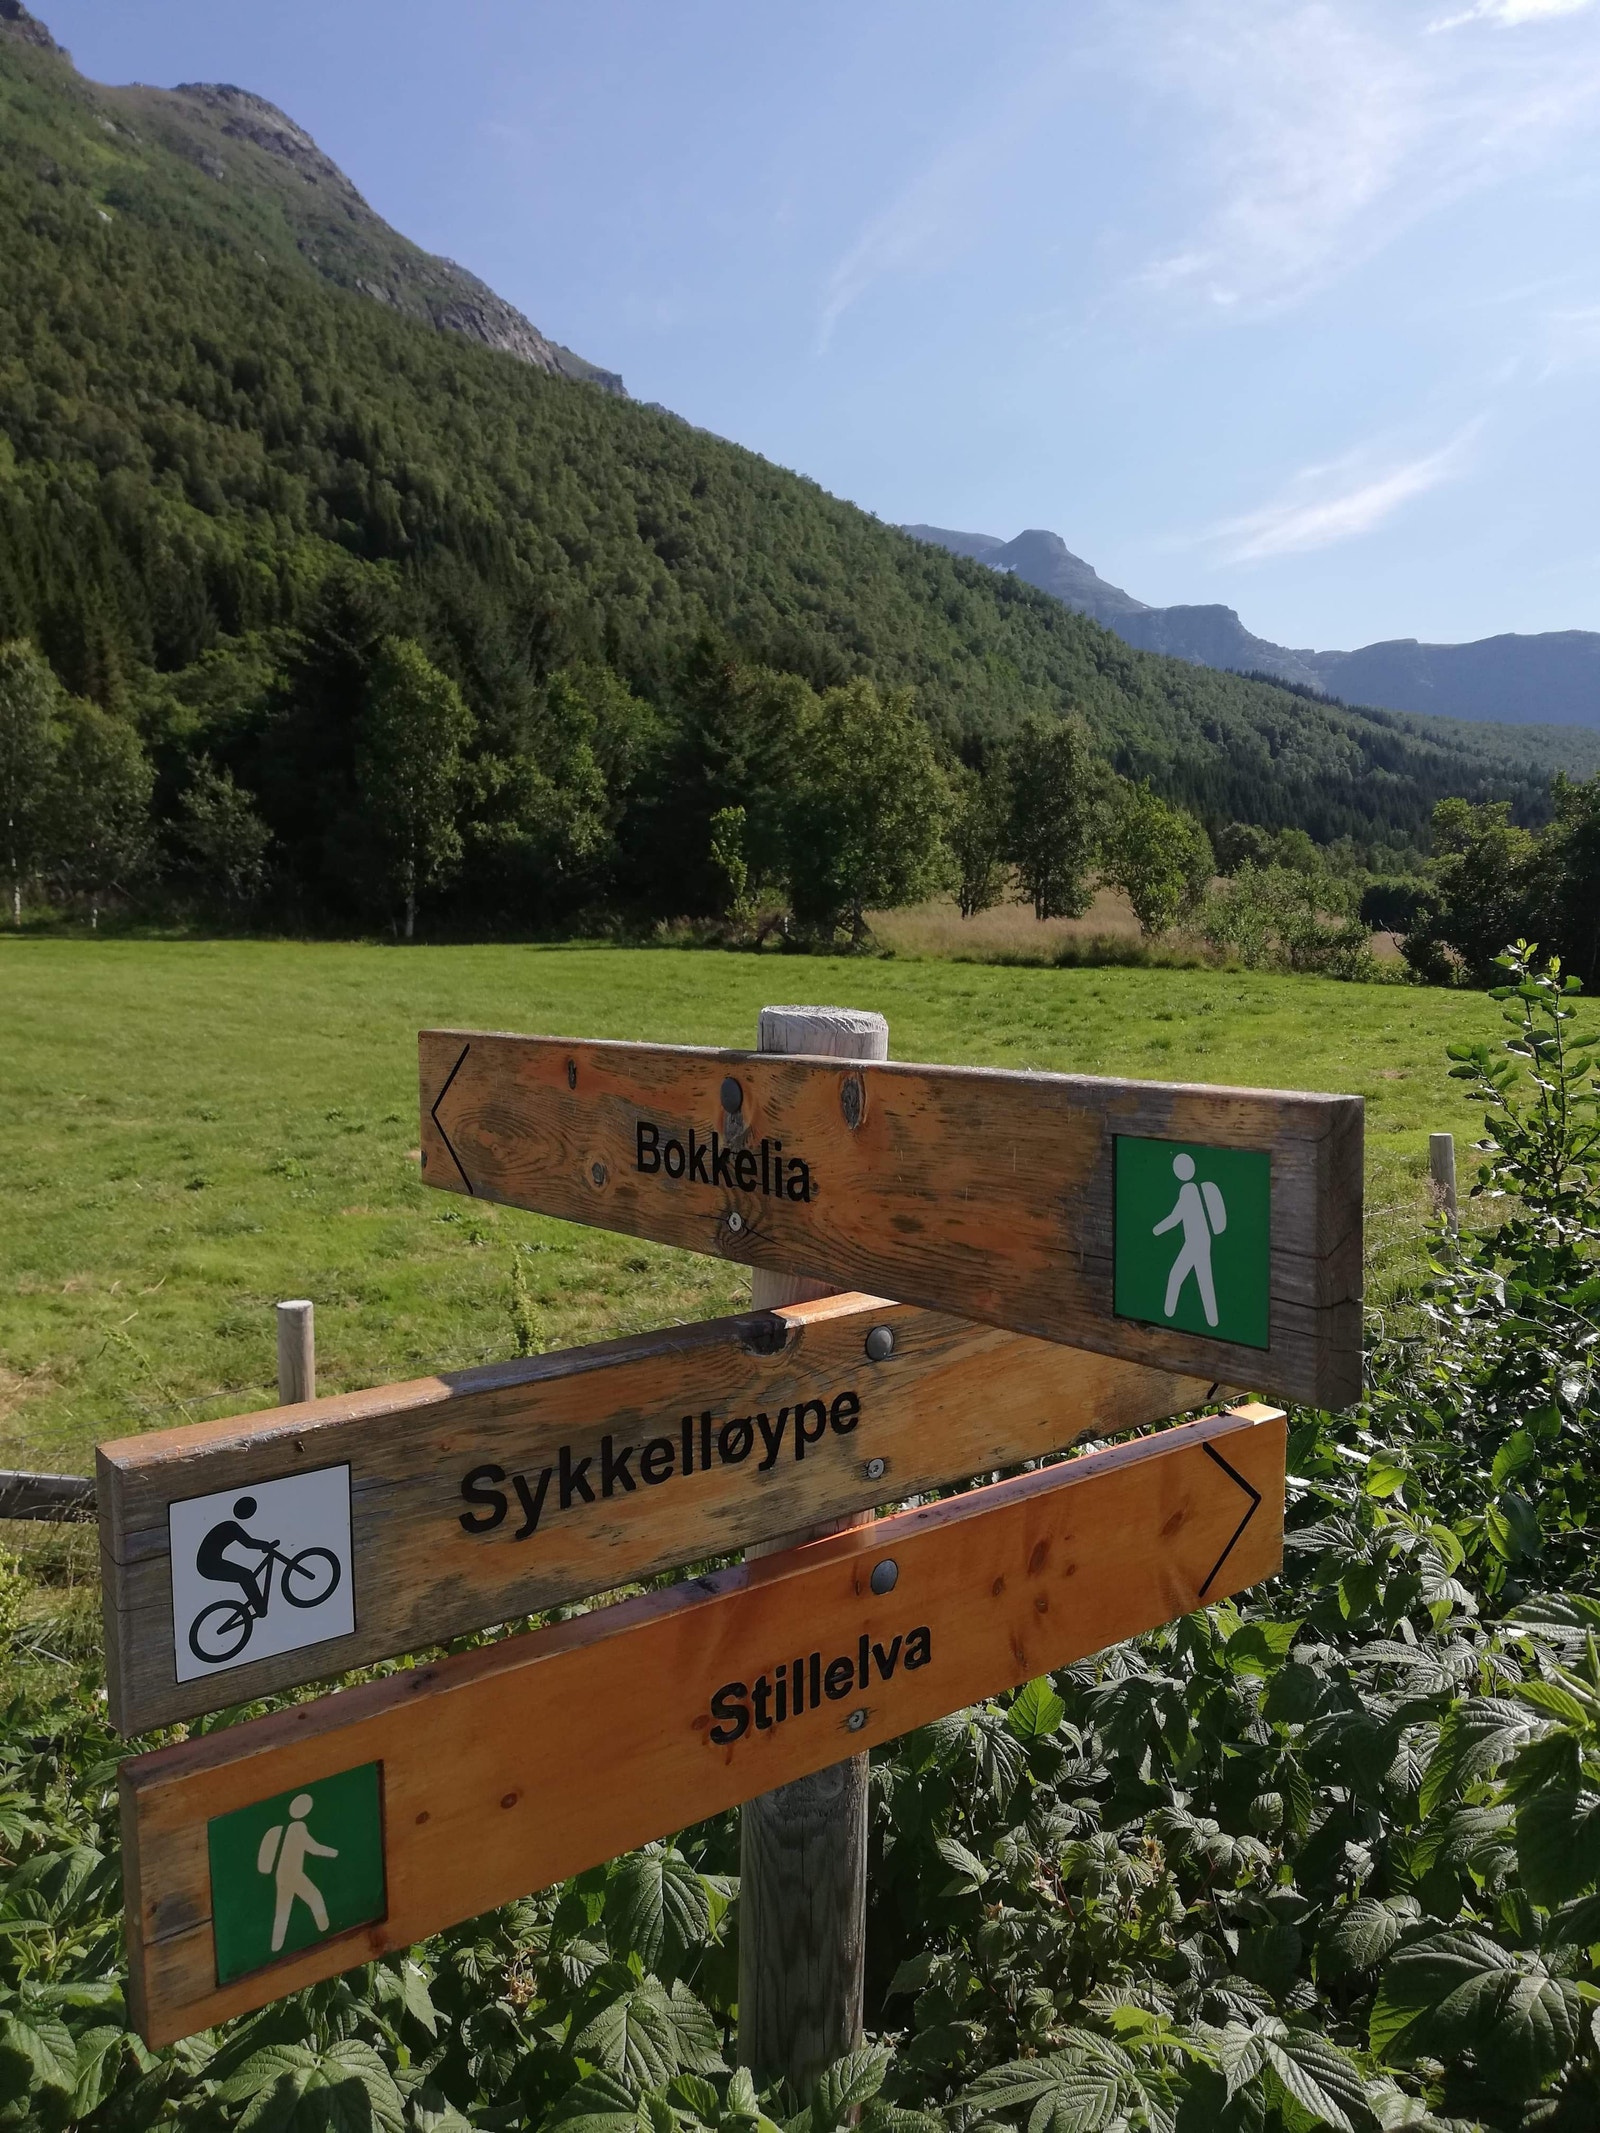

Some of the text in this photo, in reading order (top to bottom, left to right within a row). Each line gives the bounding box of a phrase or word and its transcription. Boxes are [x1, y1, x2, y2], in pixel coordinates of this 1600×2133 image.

[636, 1121, 810, 1203] Bokkelia
[459, 1391, 860, 1540] Sykkelløype
[709, 1625, 932, 1746] Stillelva
